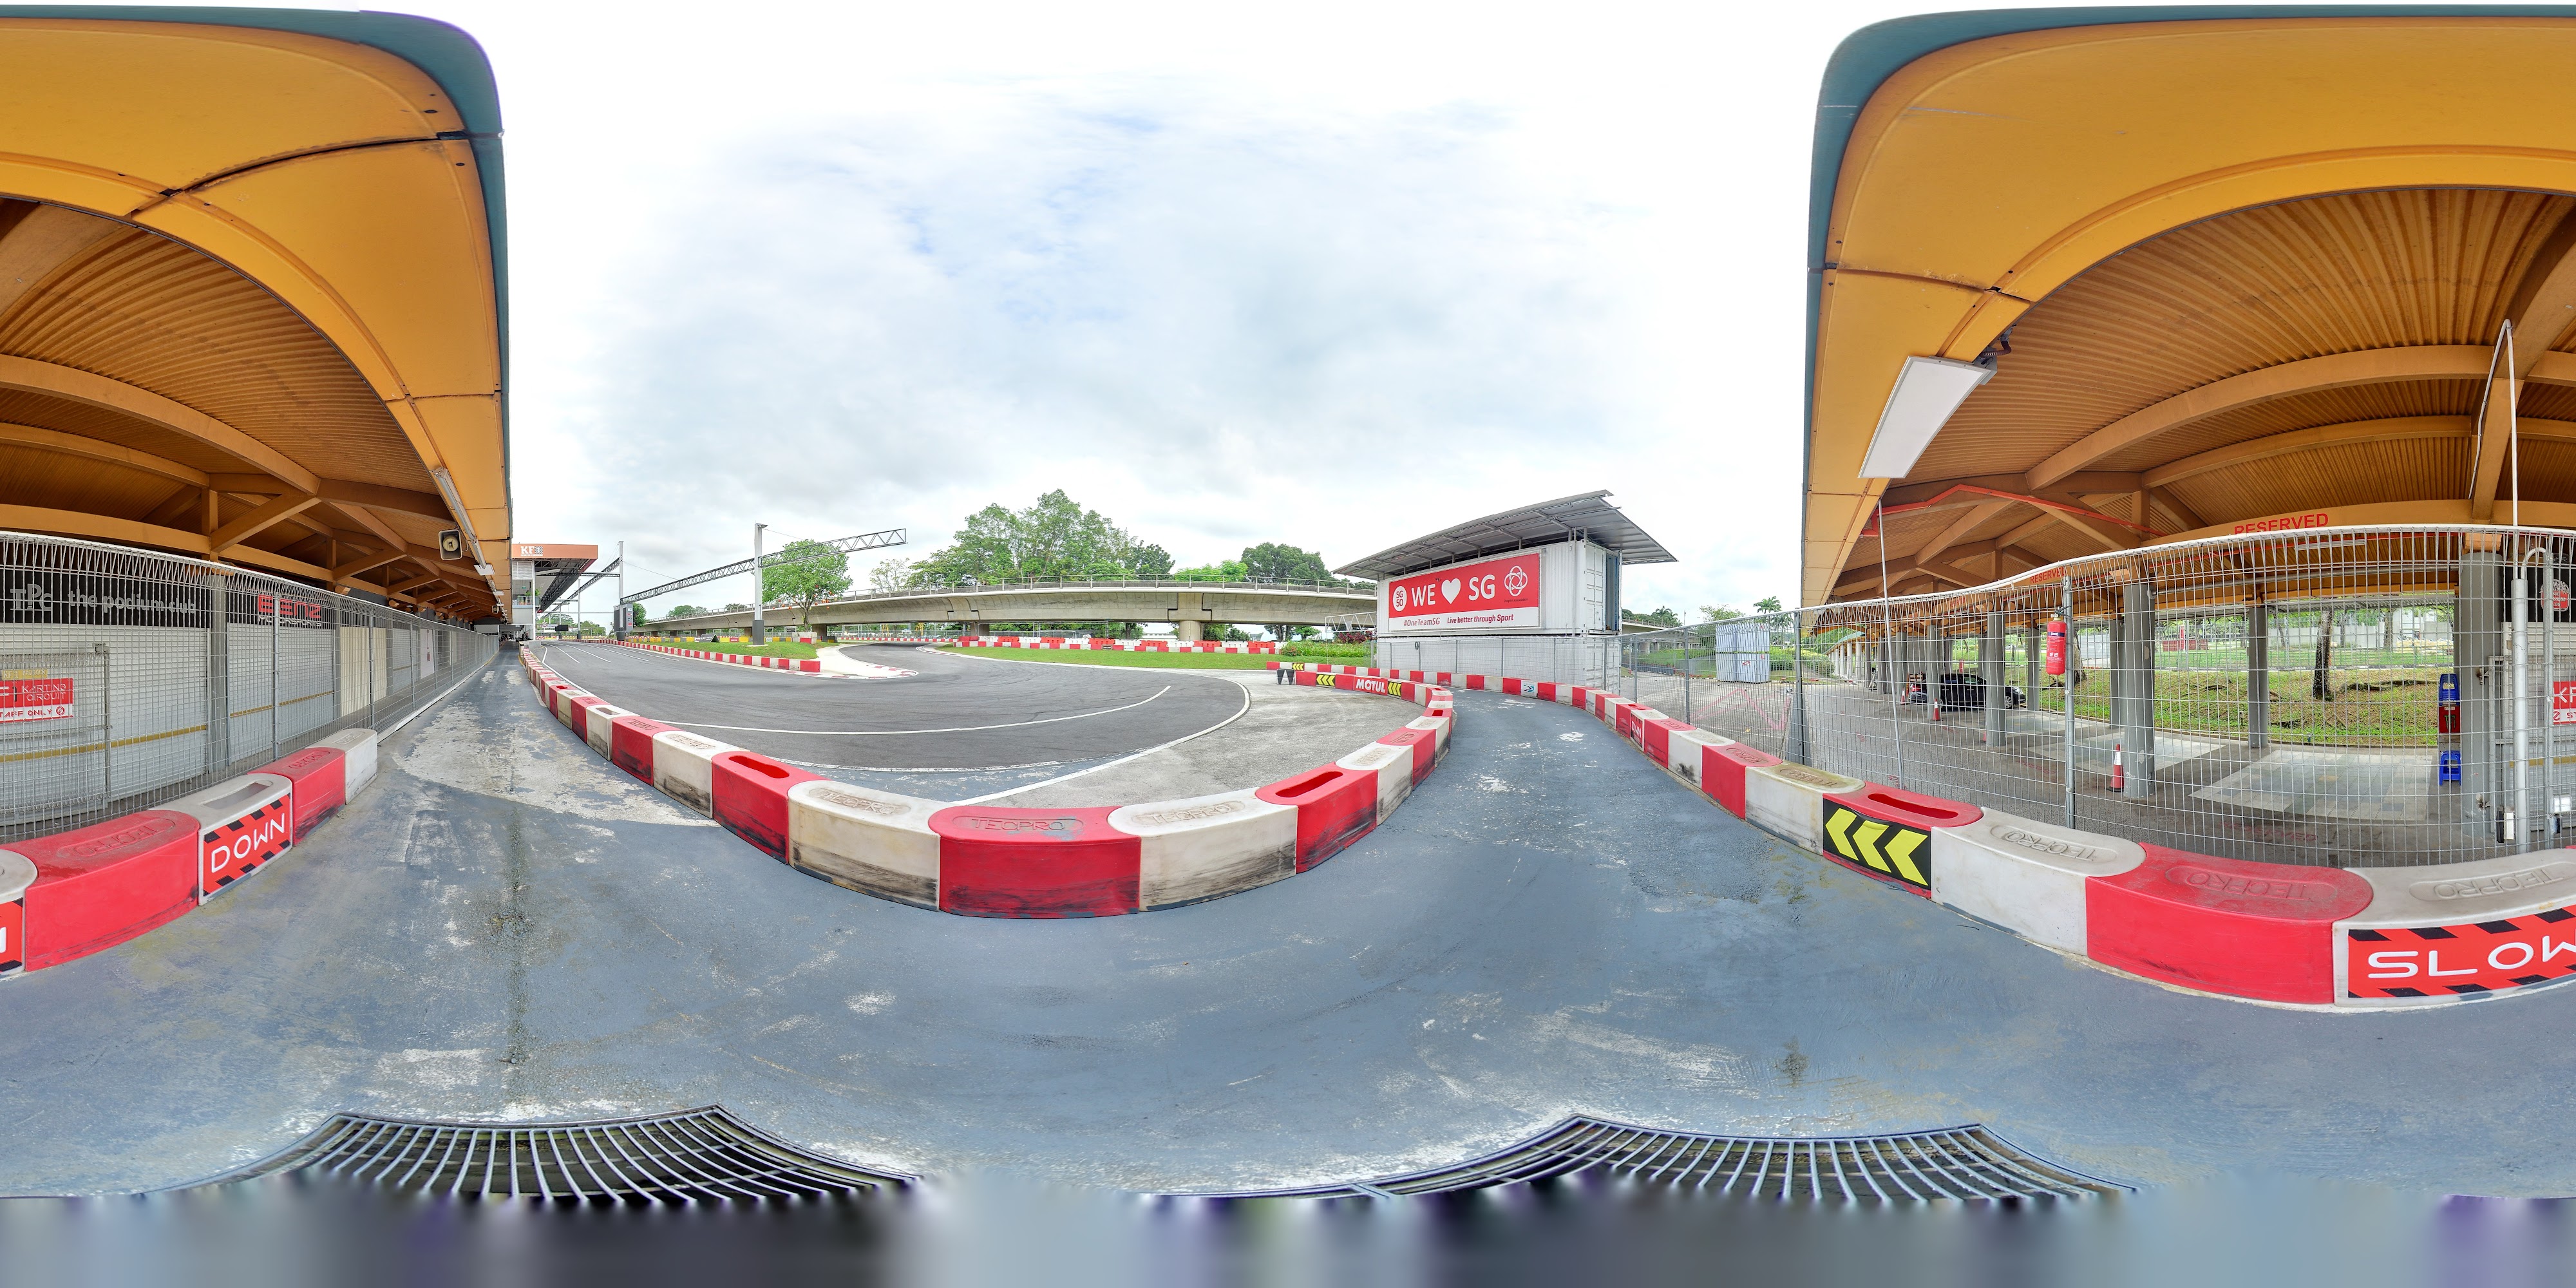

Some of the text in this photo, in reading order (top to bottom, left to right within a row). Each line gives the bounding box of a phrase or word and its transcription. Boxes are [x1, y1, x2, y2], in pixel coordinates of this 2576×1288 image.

[2234, 513, 2329, 535] RESERVED
[68, 589, 196, 614] the podium club
[1411, 574, 1495, 607] WE SG
[1396, 598, 1404, 607] 50
[1404, 618, 1441, 627] #OneTeamSG
[1497, 614, 1514, 623] Sport
[21, 683, 66, 694] KARTNG
[1356, 679, 1386, 693] MOTUL
[972, 819, 1065, 831] TECPRO
[1148, 804, 1233, 826] TECPRO
[211, 812, 286, 873] DOWN
[2003, 829, 2096, 862] TECPRO
[2433, 868, 2564, 900] TECPRO
